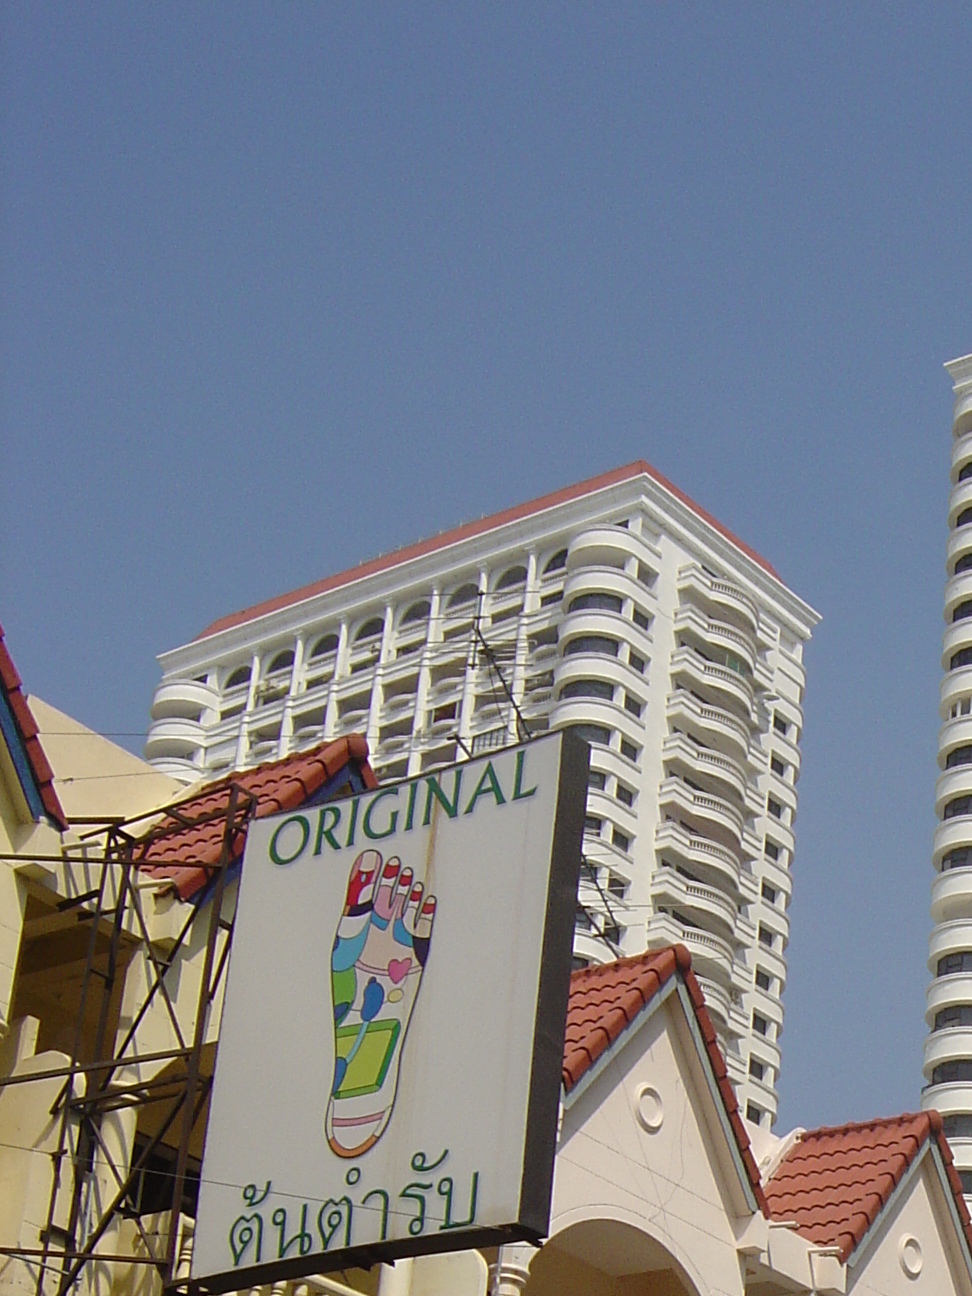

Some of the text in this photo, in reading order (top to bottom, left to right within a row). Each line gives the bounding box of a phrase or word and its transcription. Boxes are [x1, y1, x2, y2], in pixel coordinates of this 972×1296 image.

[268, 749, 539, 866] ORIGINAL
[228, 1149, 479, 1266] ต้นตำรับ
